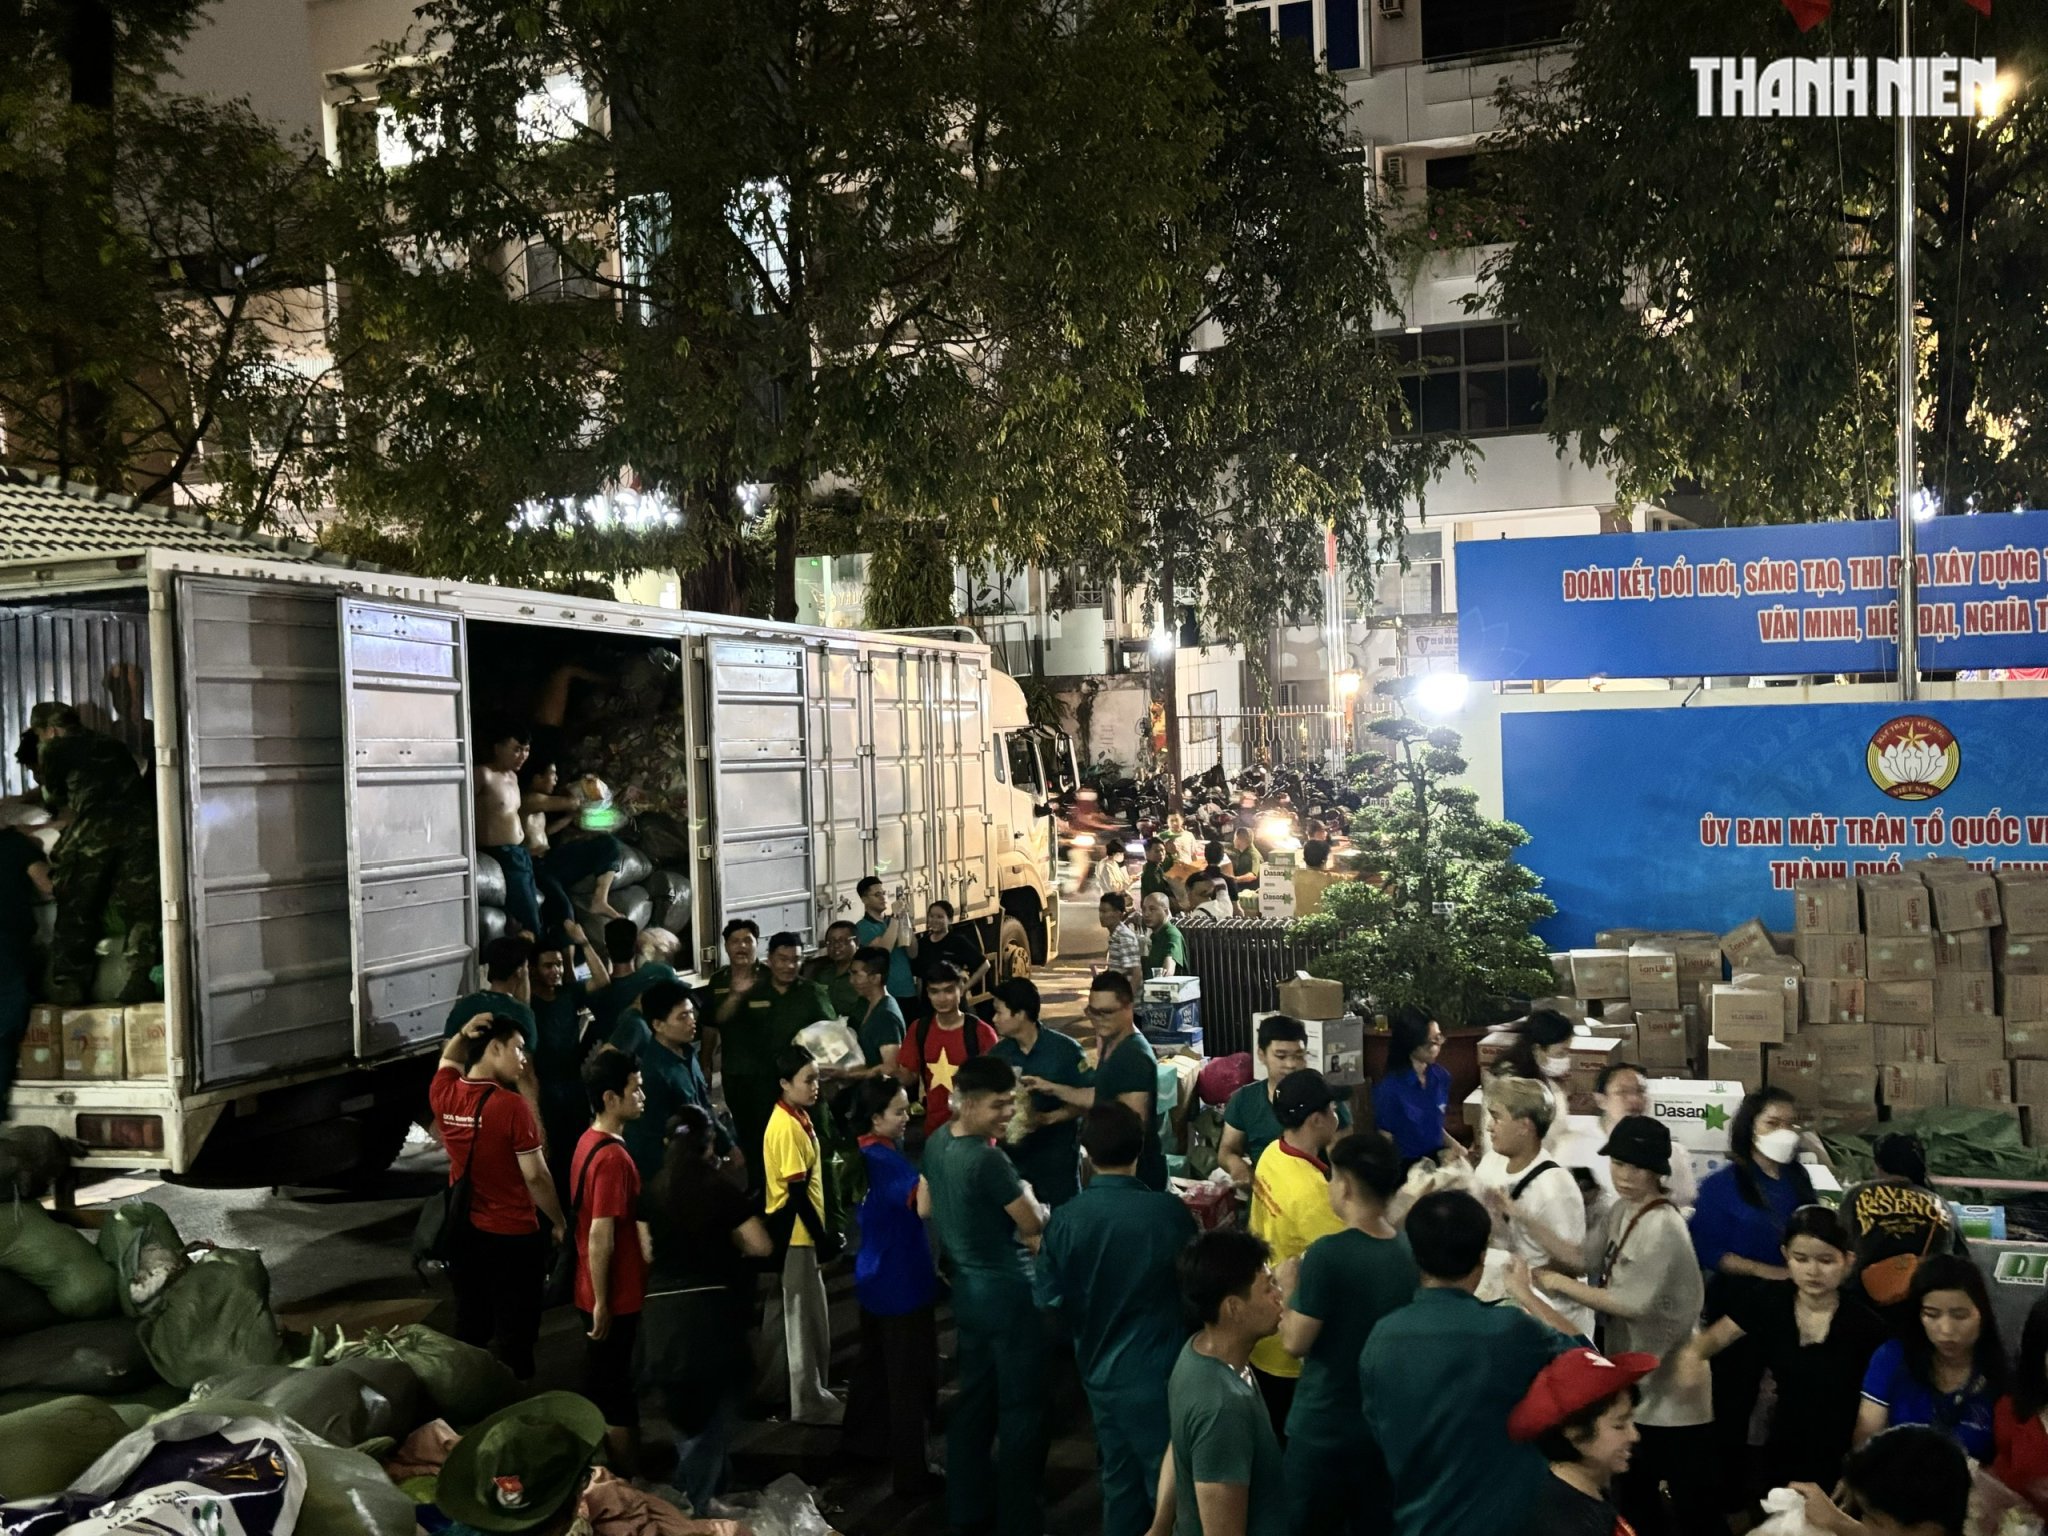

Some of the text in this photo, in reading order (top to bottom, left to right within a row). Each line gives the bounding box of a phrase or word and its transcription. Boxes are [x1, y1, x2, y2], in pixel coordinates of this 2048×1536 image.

[1563, 564, 1615, 602] ĐOÀN
[1618, 557, 1655, 602] KẾT,
[1658, 555, 1694, 598] ĐỔI
[1697, 558, 1741, 598] MỚI,
[1744, 557, 1798, 595] SÁNG
[1801, 558, 1845, 598] TẠO,
[1848, 556, 1883, 590] THI
[1933, 546, 1976, 587] XÂY
[1978, 544, 2040, 590] DỰNG
[1758, 604, 1800, 643] VĂN
[1803, 607, 1862, 643] MINH,
[1865, 600, 1899, 644] HIỆ
[1917, 602, 1960, 643] ĐẠI,
[1964, 596, 2032, 634] NGHĨA
[1700, 811, 1731, 847] ỦY
[1736, 817, 1783, 847] BAN
[1788, 812, 1839, 851] MẶT
[1843, 812, 1907, 851] TRẬN
[1911, 807, 1945, 847] TỔ
[1951, 807, 2021, 849] QUỐC
